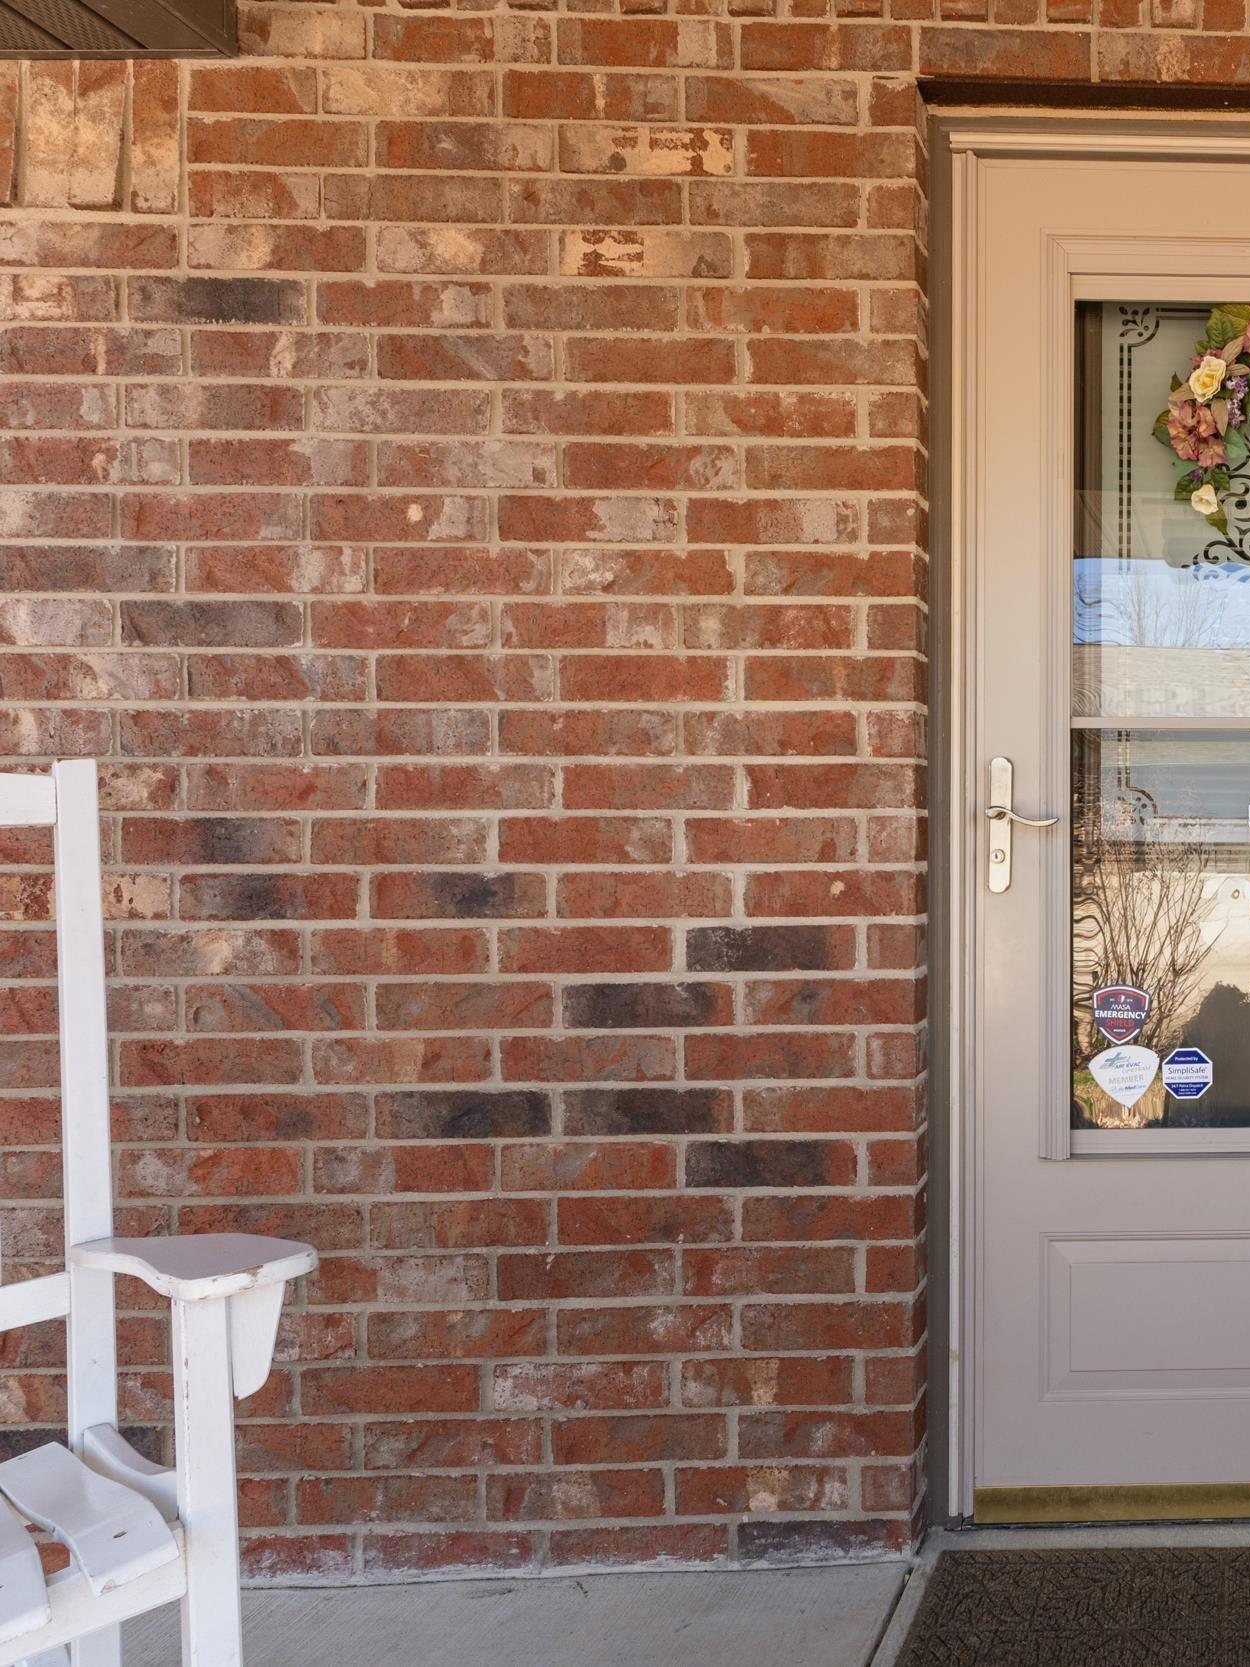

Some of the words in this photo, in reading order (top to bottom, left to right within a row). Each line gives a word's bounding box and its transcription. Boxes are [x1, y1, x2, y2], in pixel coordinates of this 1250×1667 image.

[1095, 1010, 1146, 1019] EMERGENCY
[1167, 1066, 1206, 1075] SimpliSafe
[1108, 1074, 1145, 1085] MEMBER
